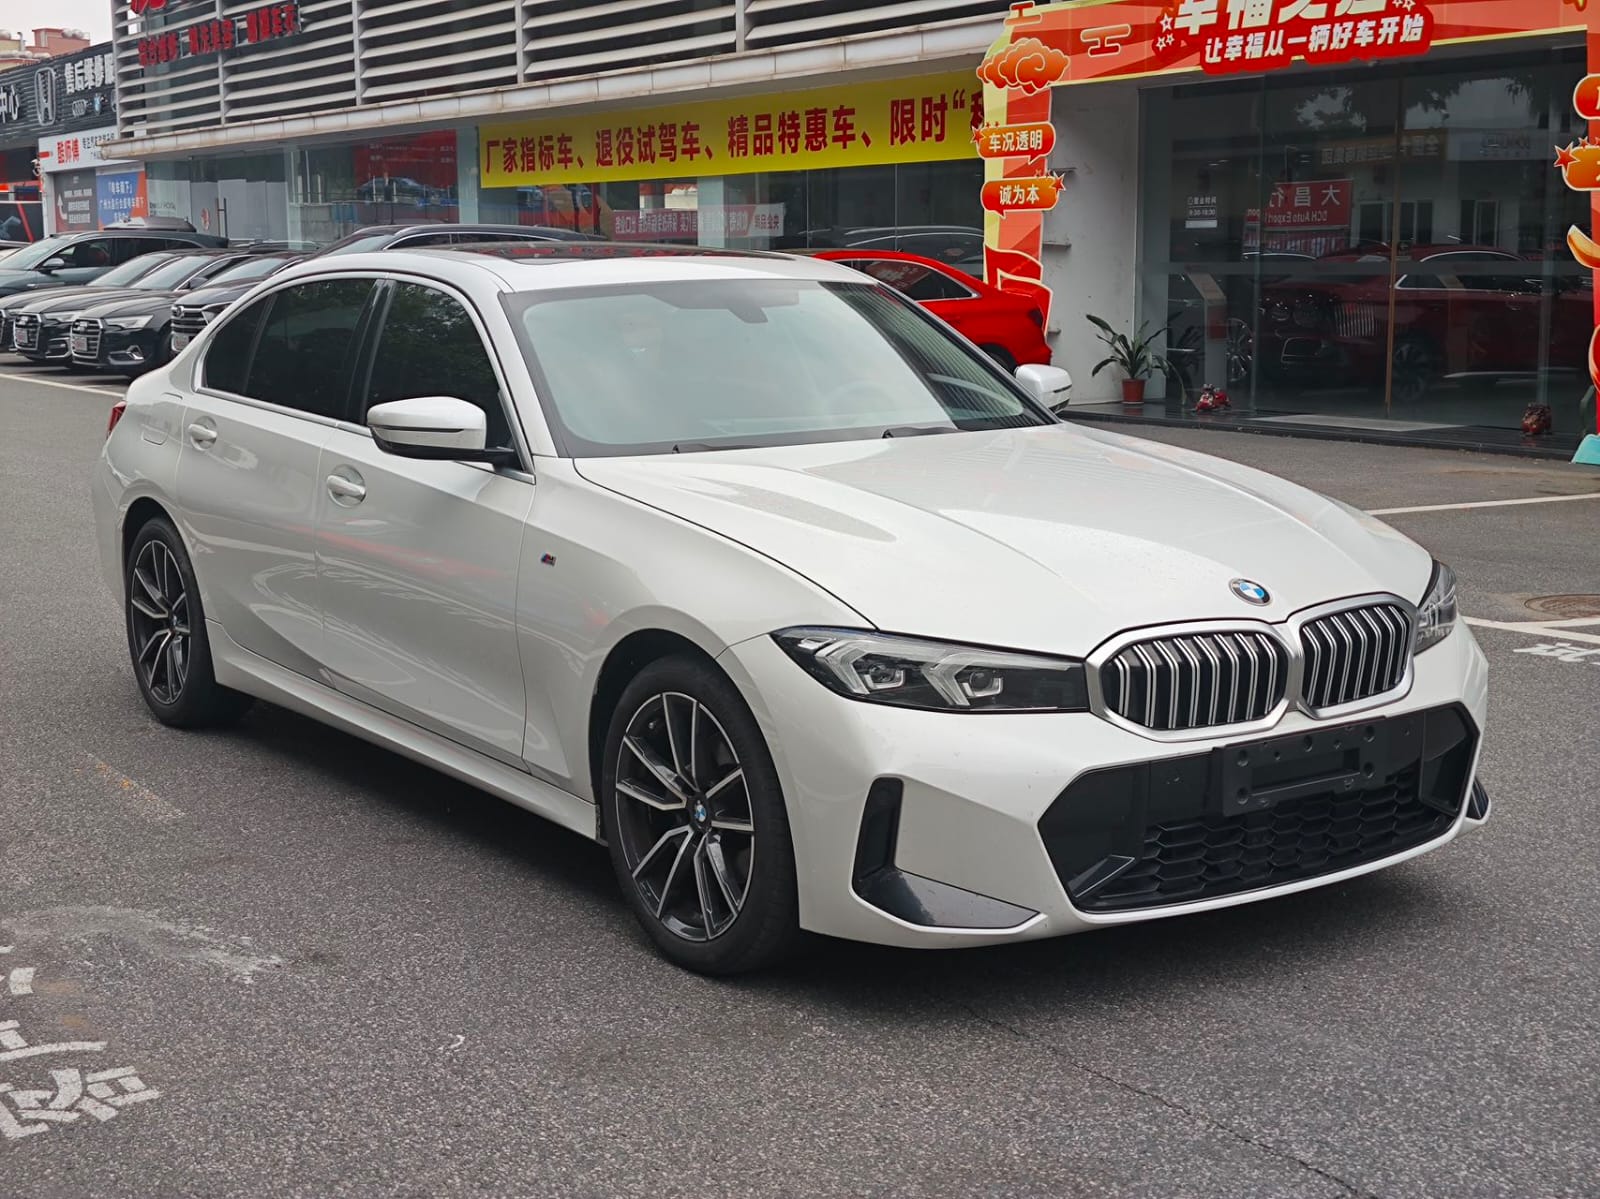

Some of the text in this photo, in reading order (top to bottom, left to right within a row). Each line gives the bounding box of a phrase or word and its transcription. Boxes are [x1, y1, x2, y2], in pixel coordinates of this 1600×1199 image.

[1205, 14, 1424, 64] 让幸福从一辆好车开始
[988, 129, 1043, 152] 车况透明
[999, 184, 1040, 205] 诚为本
